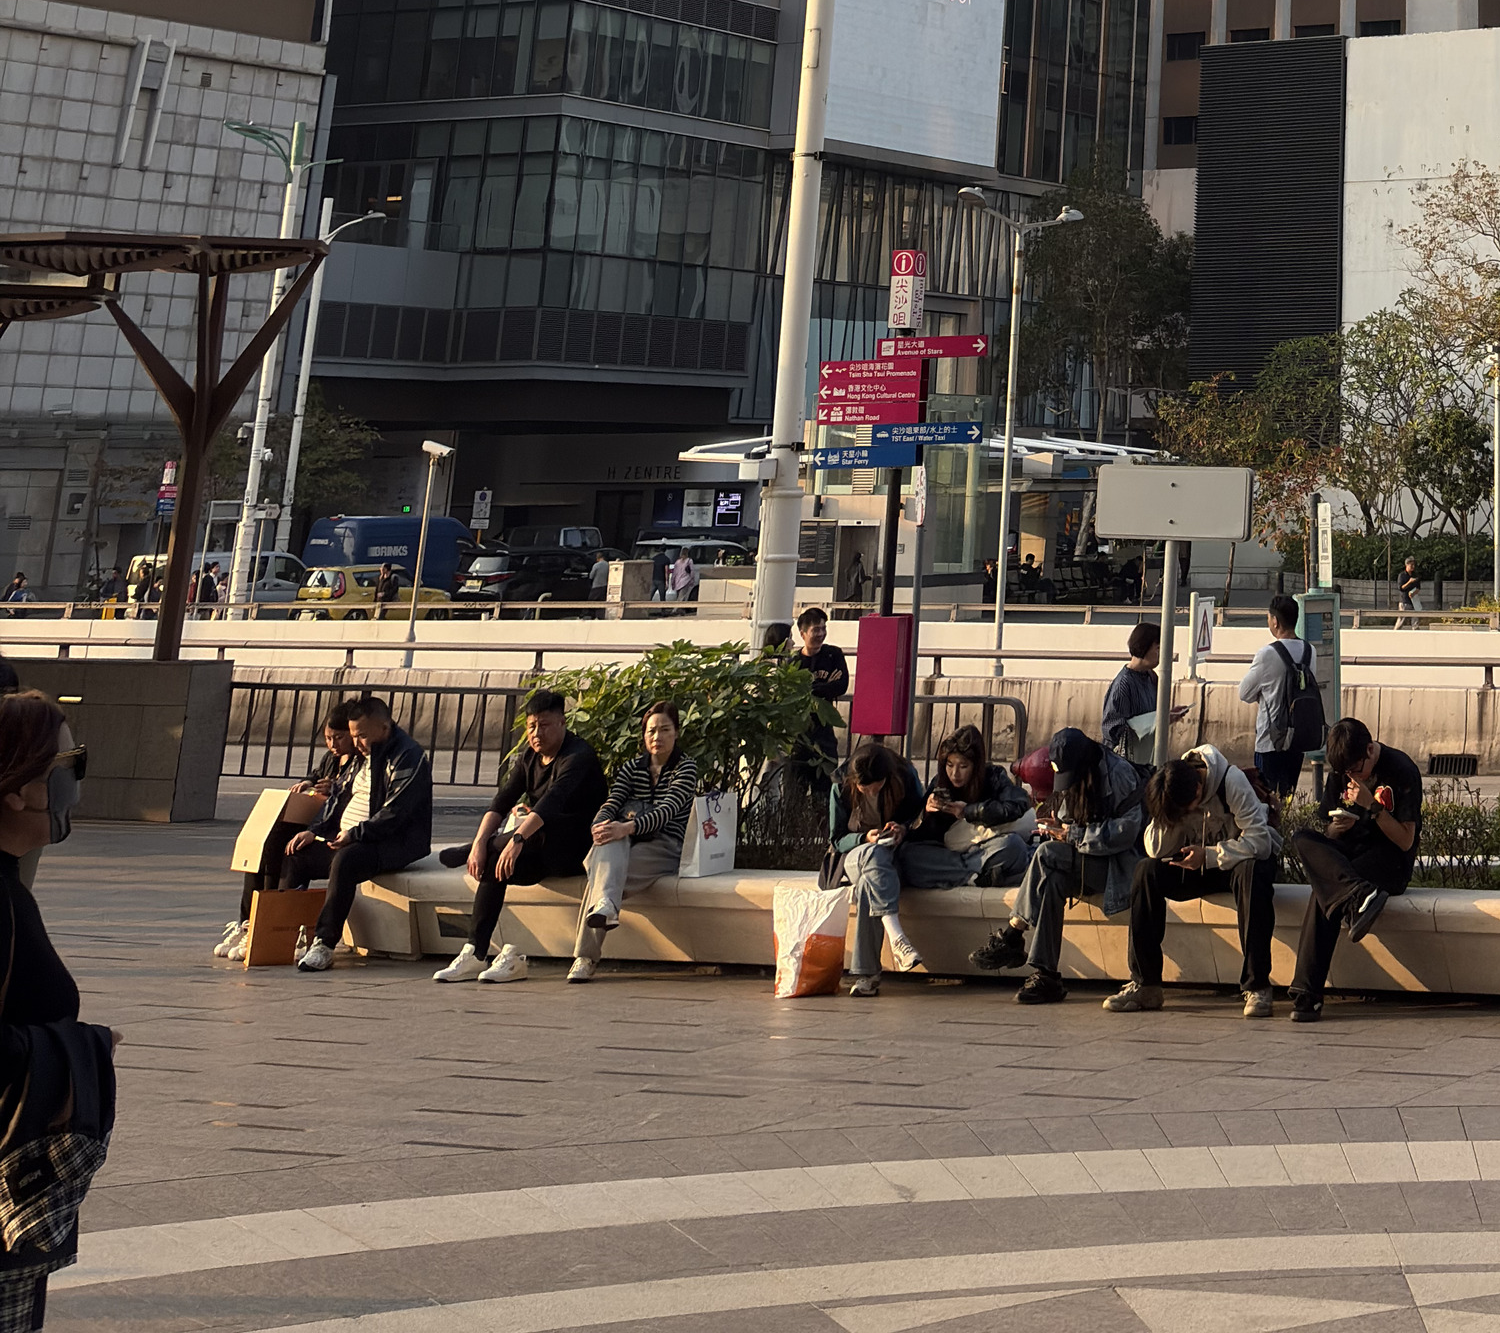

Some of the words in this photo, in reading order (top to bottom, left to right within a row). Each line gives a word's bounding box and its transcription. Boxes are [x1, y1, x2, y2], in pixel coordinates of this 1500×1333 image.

[893, 278, 908, 326] 尖沙咀
[847, 393, 861, 401] Hong
[861, 393, 876, 401] Kong
[606, 466, 616, 480] H
[624, 465, 681, 480] ZENTRE
